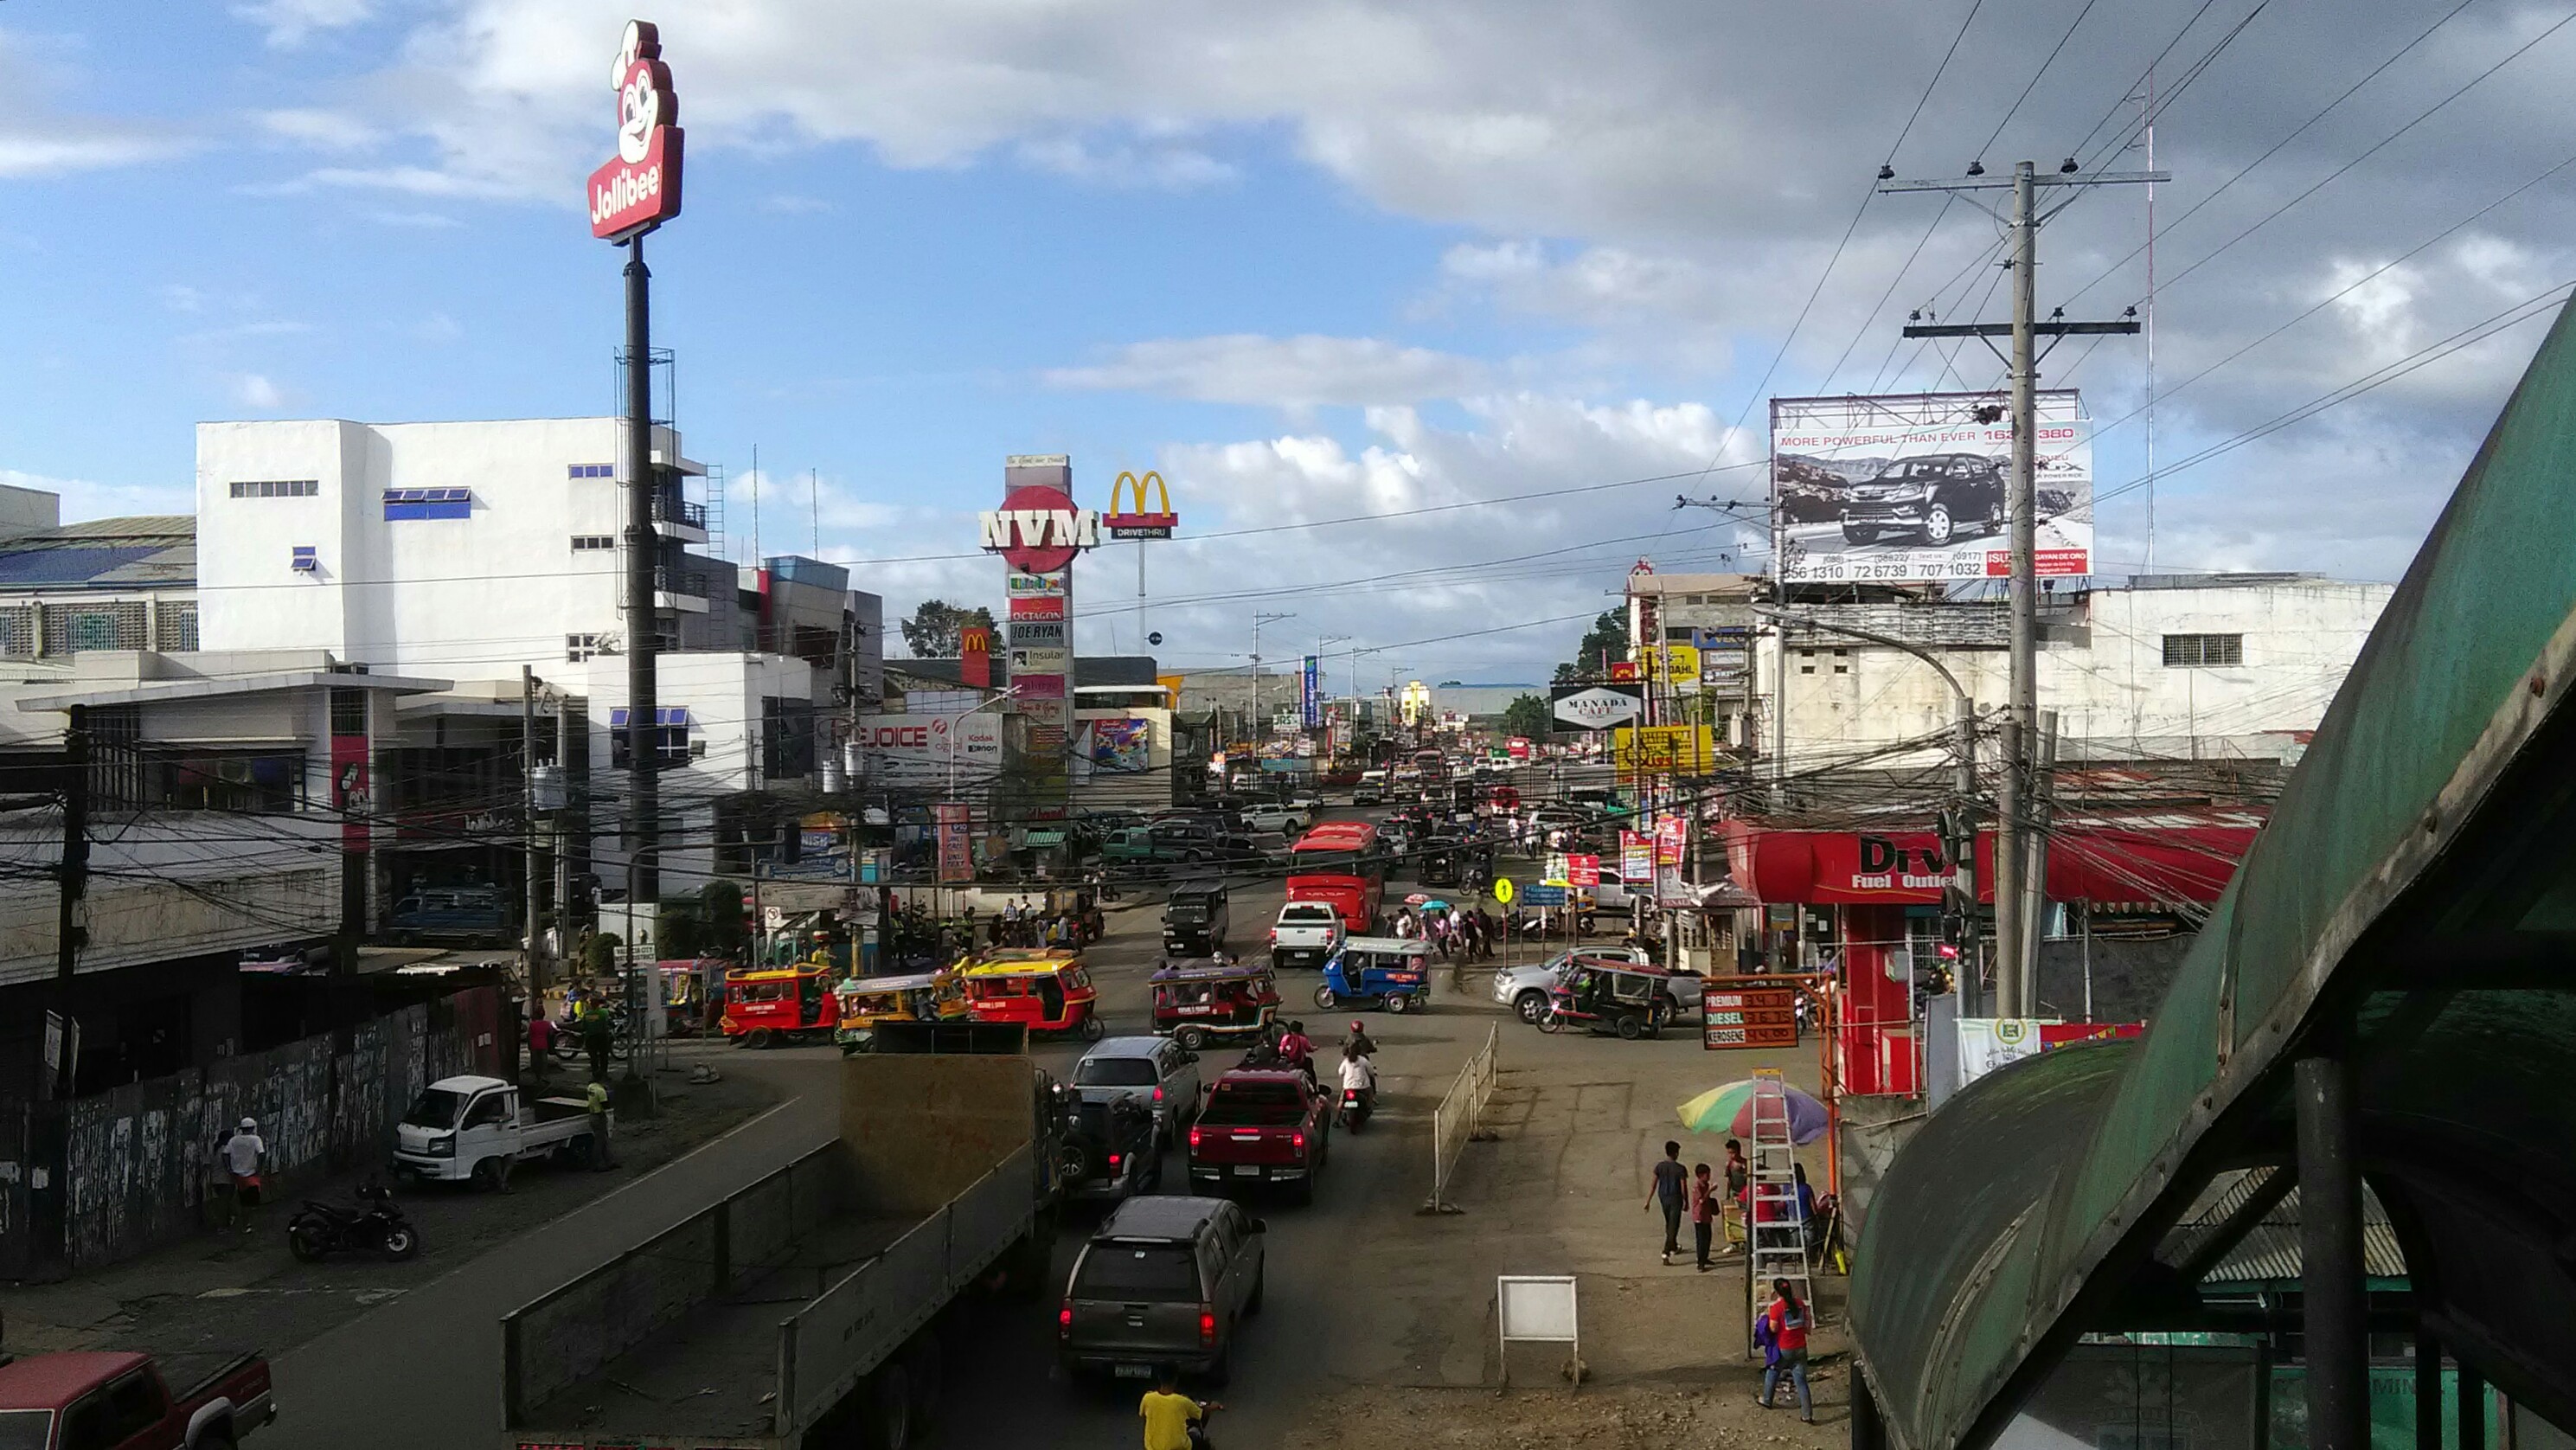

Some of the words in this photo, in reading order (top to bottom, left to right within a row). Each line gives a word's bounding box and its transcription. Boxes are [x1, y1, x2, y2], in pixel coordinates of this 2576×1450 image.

[592, 167, 660, 224] Jollibee
[1780, 436, 1820, 446] MORE
[1823, 434, 1897, 446] POWERFUL
[1902, 433, 1937, 444] THAN
[1941, 432, 1976, 443] EVER
[2038, 428, 2073, 439] 380
[978, 510, 1095, 547] NVM
[1952, 552, 1982, 561] (0917)
[1812, 566, 1844, 579] 1310
[1854, 566, 1871, 578] 72
[1874, 564, 1907, 577] 6739
[1919, 564, 1944, 577] 707
[1947, 562, 1982, 575] 1032
[1013, 612, 1062, 620] OCTAGON
[1012, 626, 1031, 638] JOE
[1033, 625, 1063, 638] RYAN
[1029, 651, 1064, 660] Insular
[1568, 698, 1628, 708] MANADA
[968, 734, 994, 742] Kodak
[1851, 875, 1892, 889] Fuel
[1706, 995, 1742, 1007] PREMIUM
[1707, 1012, 1744, 1025] DIESEL
[1708, 1030, 1745, 1043] KEROSENE
